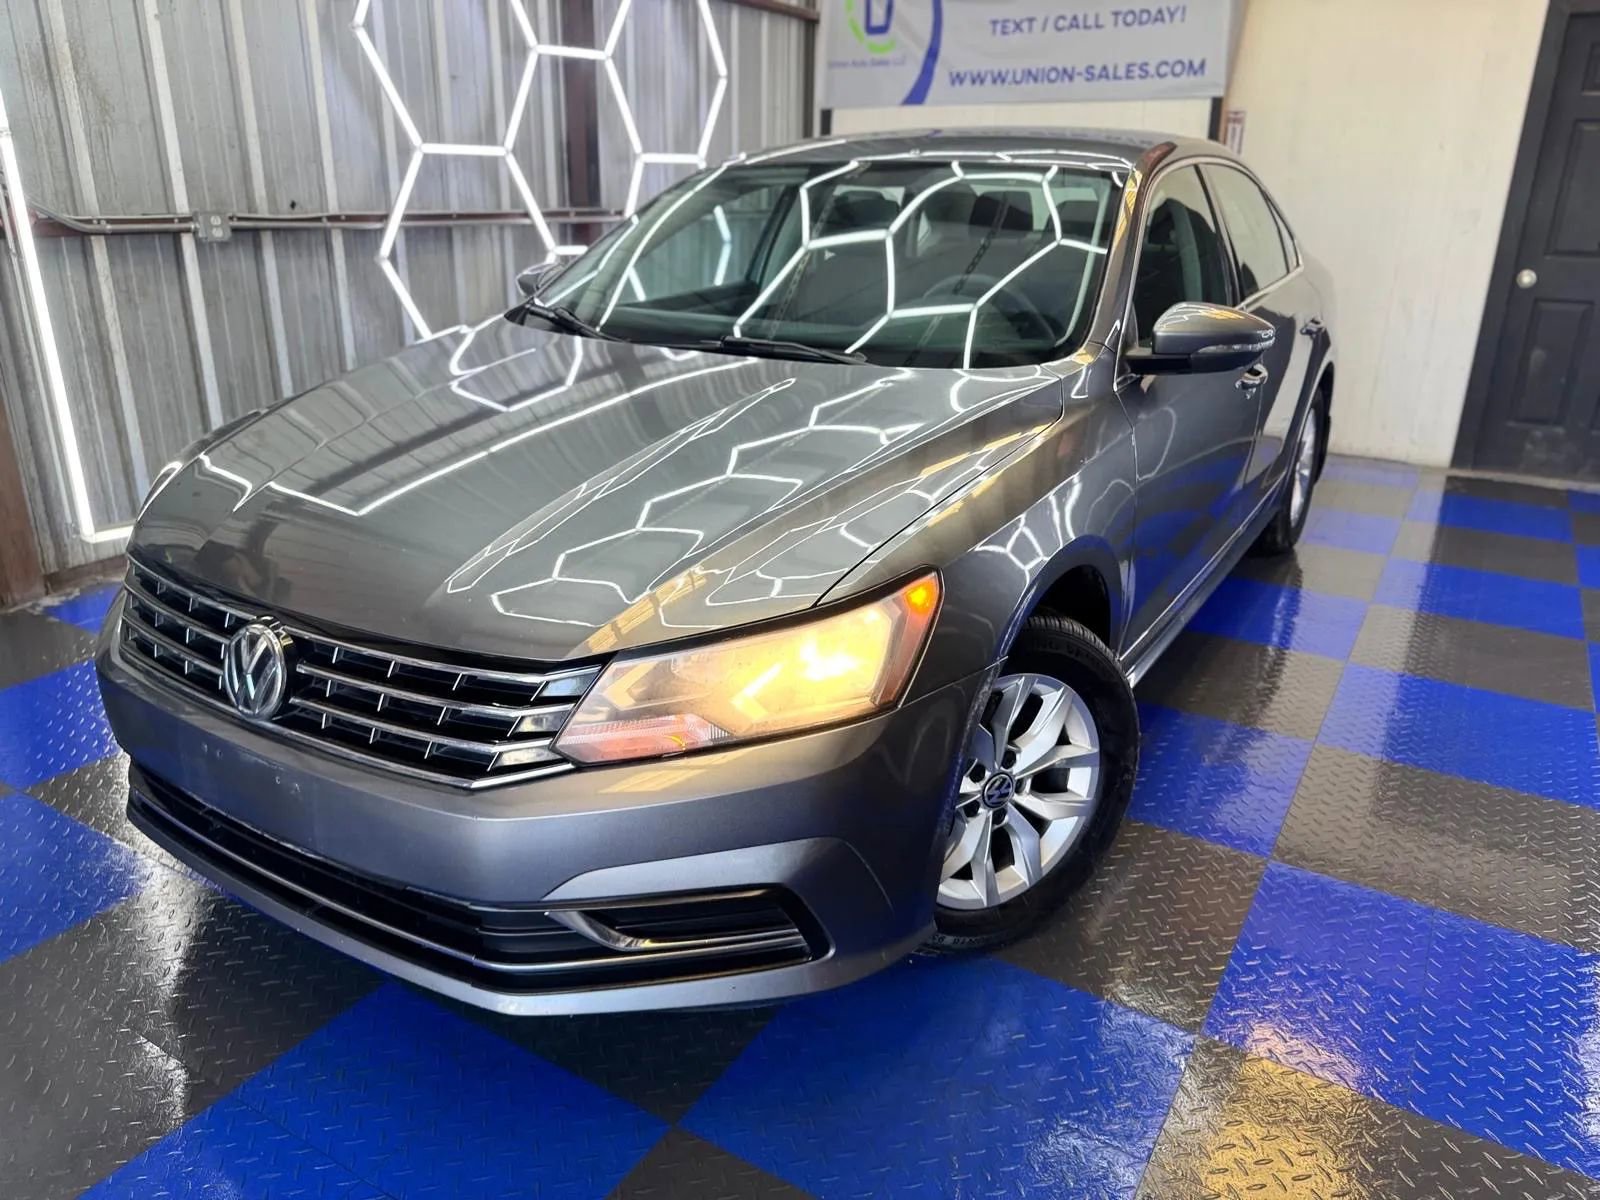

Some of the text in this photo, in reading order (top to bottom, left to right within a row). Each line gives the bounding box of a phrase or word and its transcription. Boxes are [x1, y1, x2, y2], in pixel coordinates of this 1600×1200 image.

[990, 5, 1188, 36] TEXT / CALL TODAY!
[949, 58, 1207, 87] WWW.UNION-SALES.COM
